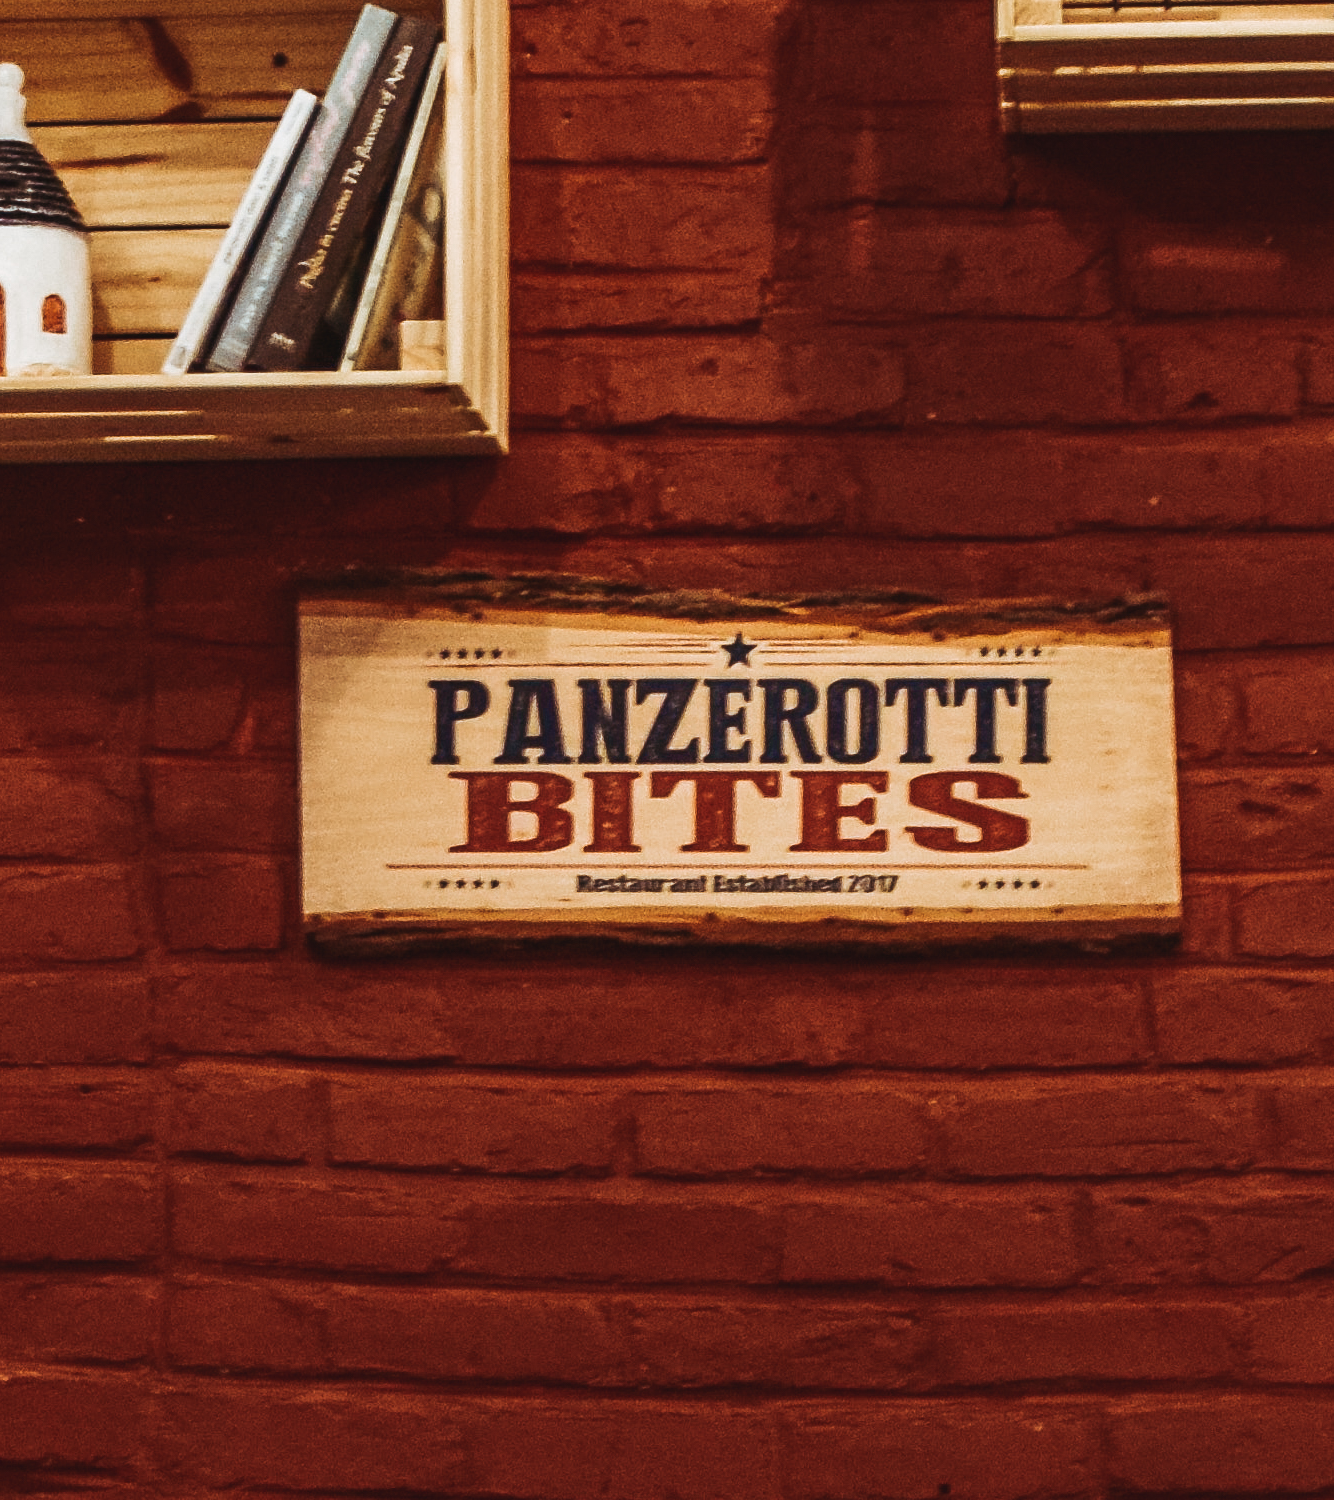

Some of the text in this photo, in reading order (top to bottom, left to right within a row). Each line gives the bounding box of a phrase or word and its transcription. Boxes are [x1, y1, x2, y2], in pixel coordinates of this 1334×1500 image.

[384, 44, 414, 90] Apulia
[378, 87, 396, 106] of
[341, 159, 365, 184] The
[427, 677, 1053, 766] PANZEROTTI
[447, 770, 1031, 854] BITES
[576, 874, 707, 893] Restaurant
[713, 873, 843, 893] Established
